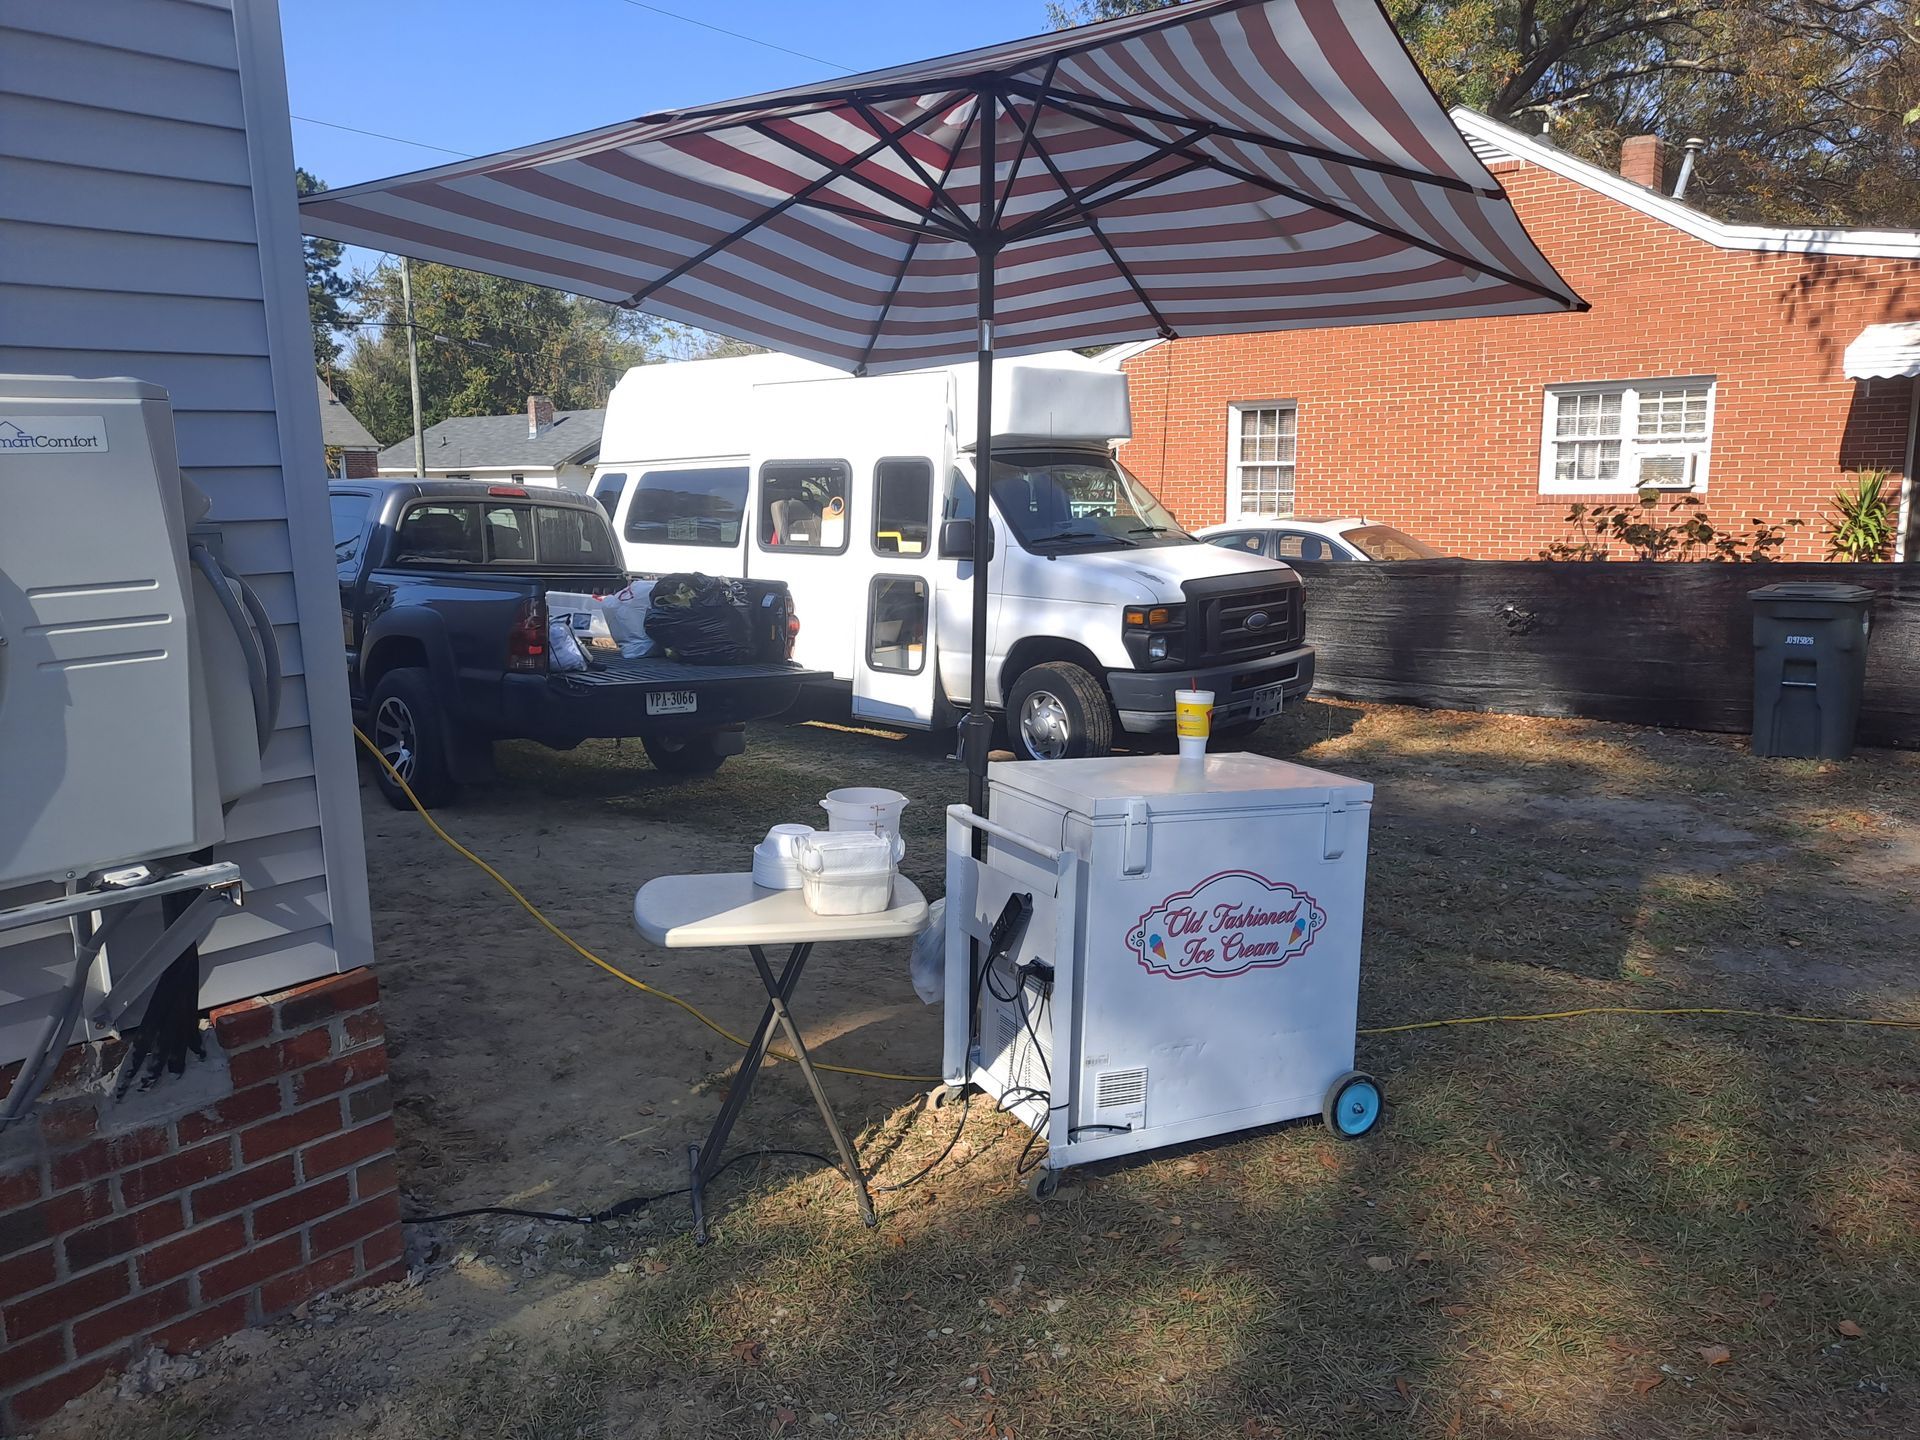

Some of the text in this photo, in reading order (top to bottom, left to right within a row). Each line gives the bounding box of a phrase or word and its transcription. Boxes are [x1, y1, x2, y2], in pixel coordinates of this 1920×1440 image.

[0, 435, 98, 448] martComfort
[650, 691, 695, 707] VPA-3066
[1164, 901, 1302, 938] Old Fashioned
[1179, 931, 1280, 967] Ice Cream
